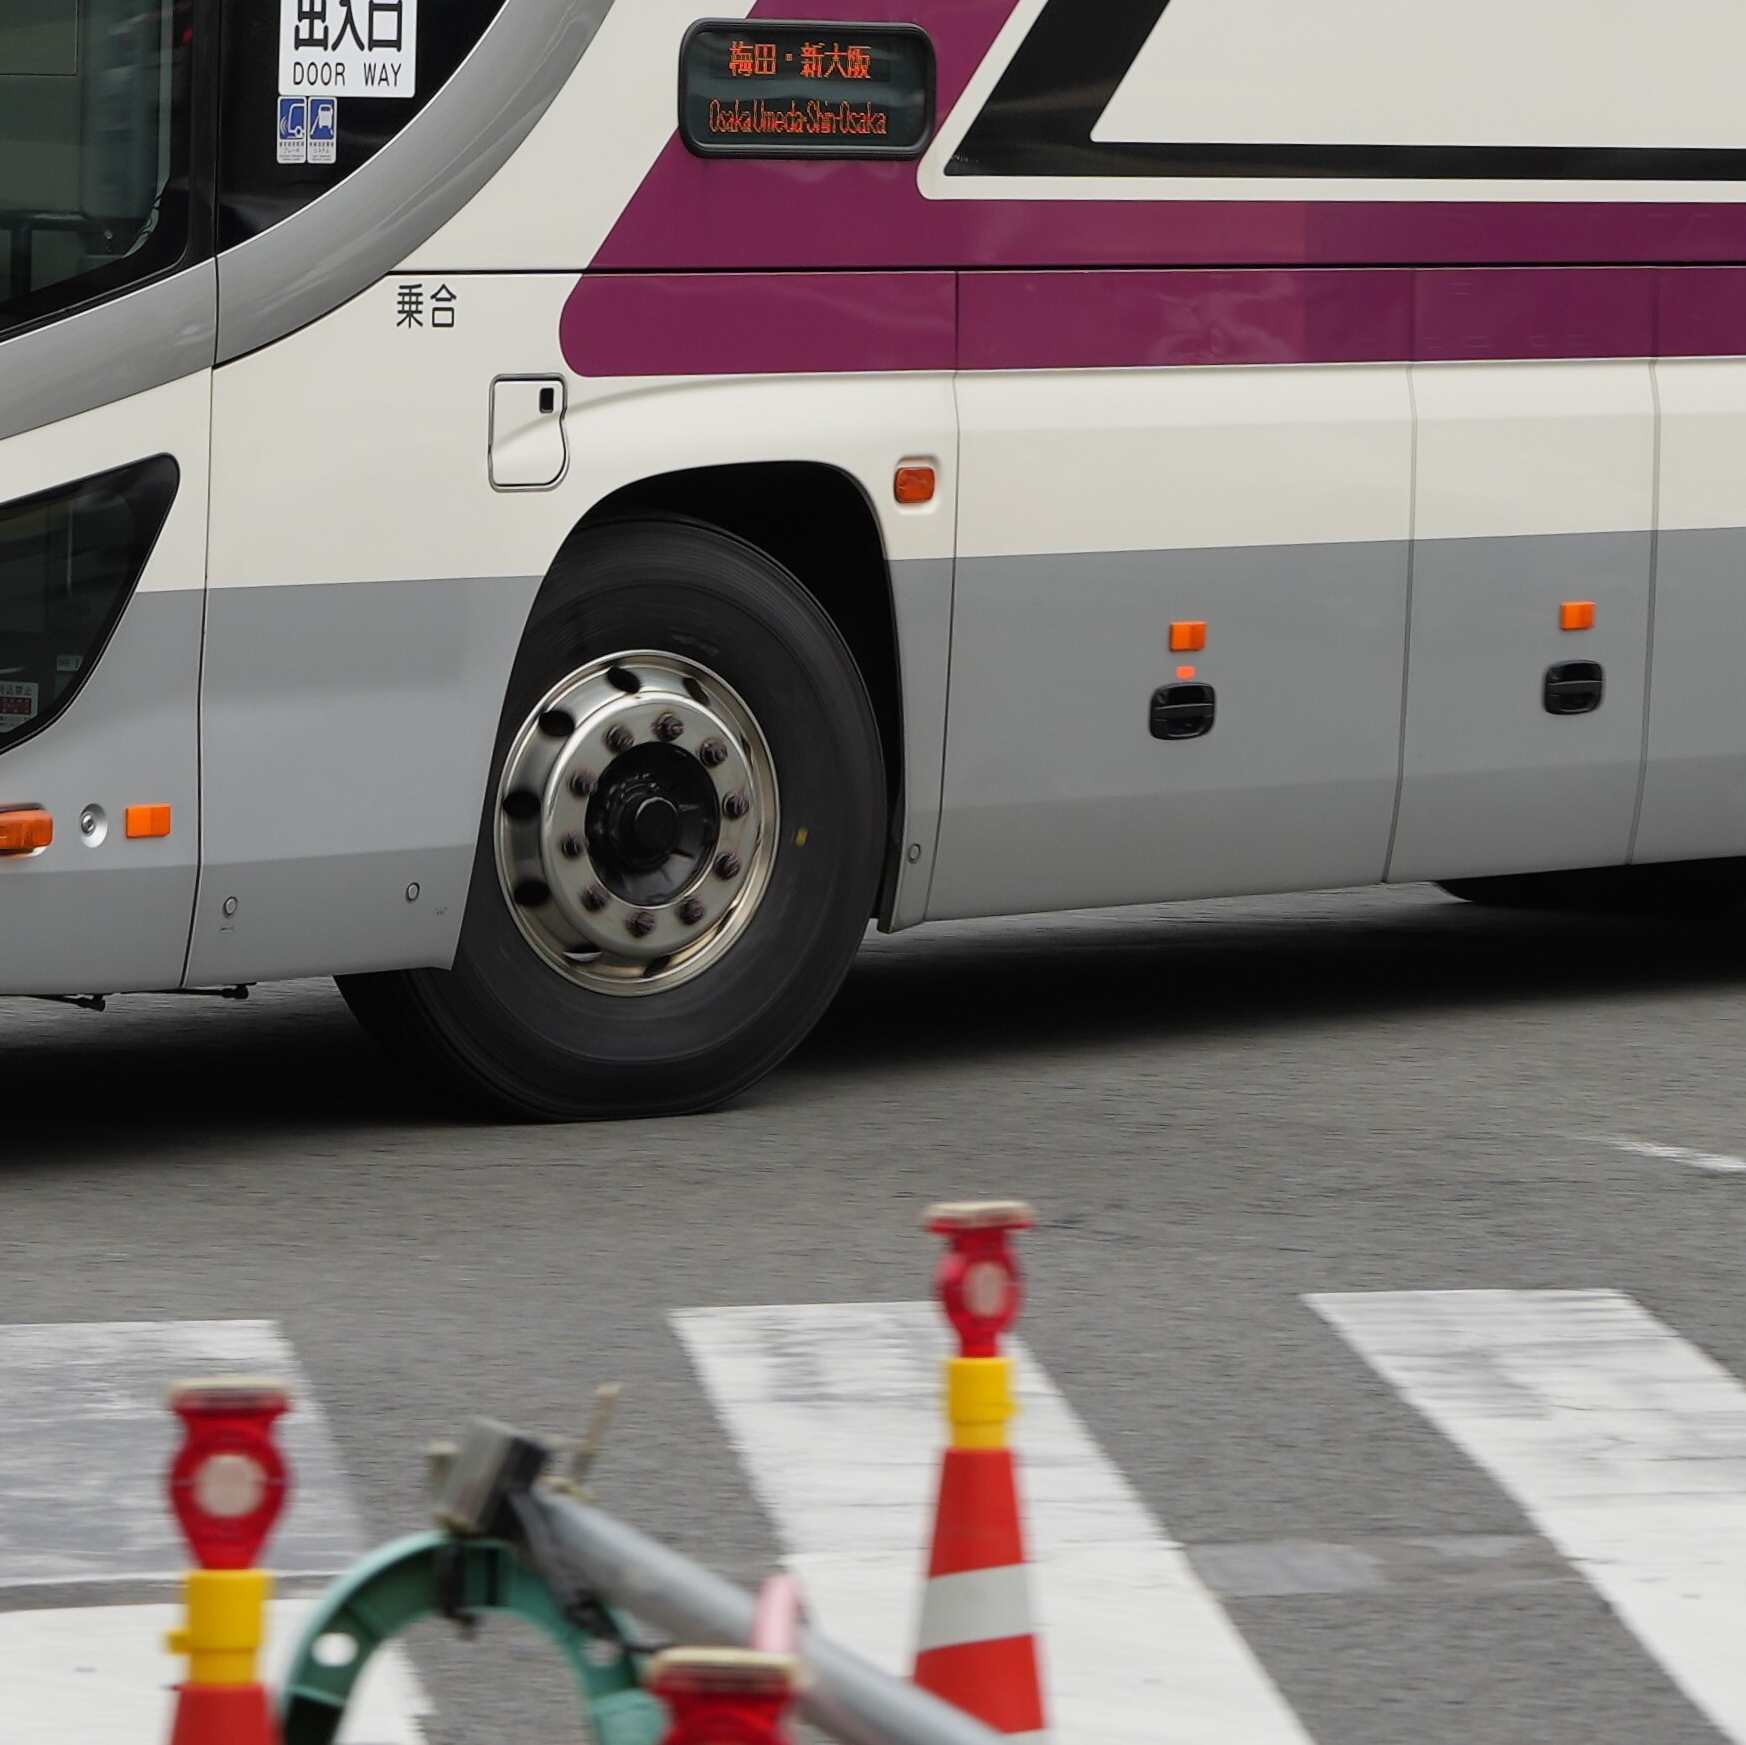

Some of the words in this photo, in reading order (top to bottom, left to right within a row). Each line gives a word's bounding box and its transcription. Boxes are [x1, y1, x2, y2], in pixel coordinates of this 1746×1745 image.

[293, 61, 346, 86] DOOR
[363, 62, 403, 87] WAY
[728, 40, 872, 79] 梅田・新大阪
[709, 99, 752, 133] Osaka
[396, 283, 457, 329] 乗合
